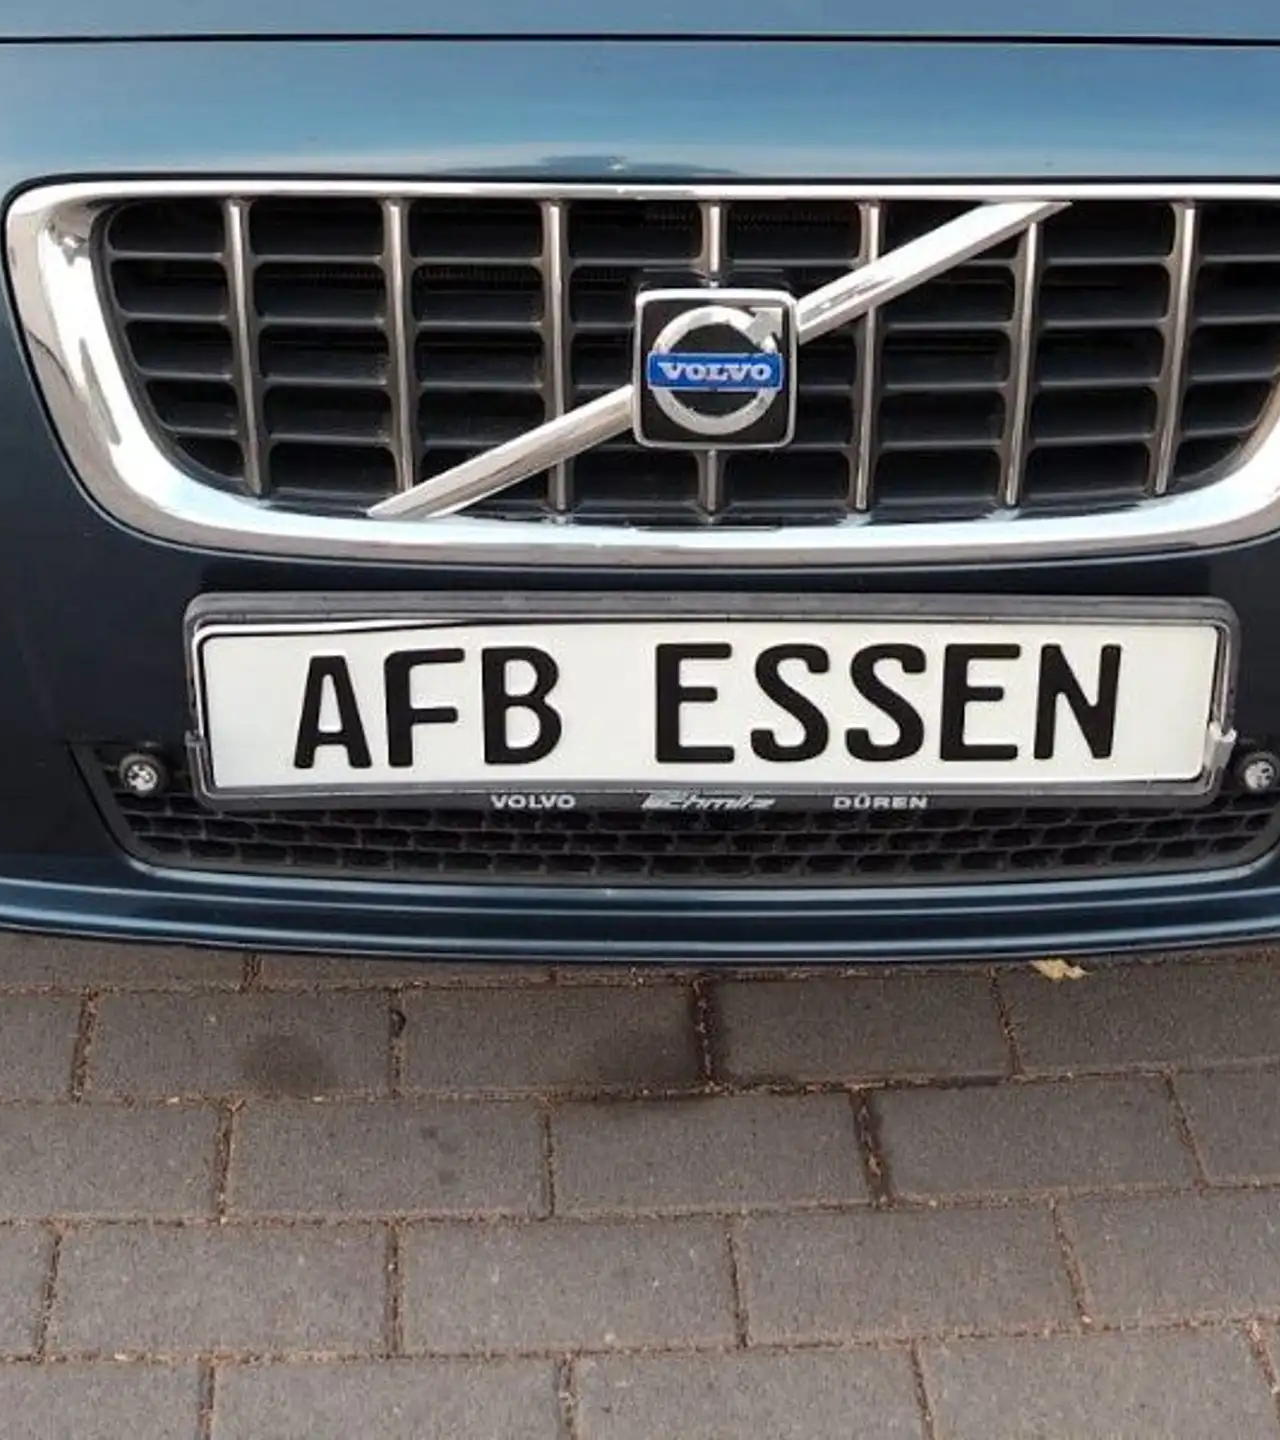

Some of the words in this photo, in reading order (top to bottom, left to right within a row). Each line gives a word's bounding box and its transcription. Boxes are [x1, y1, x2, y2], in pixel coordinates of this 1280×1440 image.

[657, 362, 772, 381] VOLVO
[293, 646, 562, 768] AFB
[655, 643, 1122, 764] ESSEN
[491, 794, 576, 809] VOLVO
[833, 792, 928, 810] DÜREN
